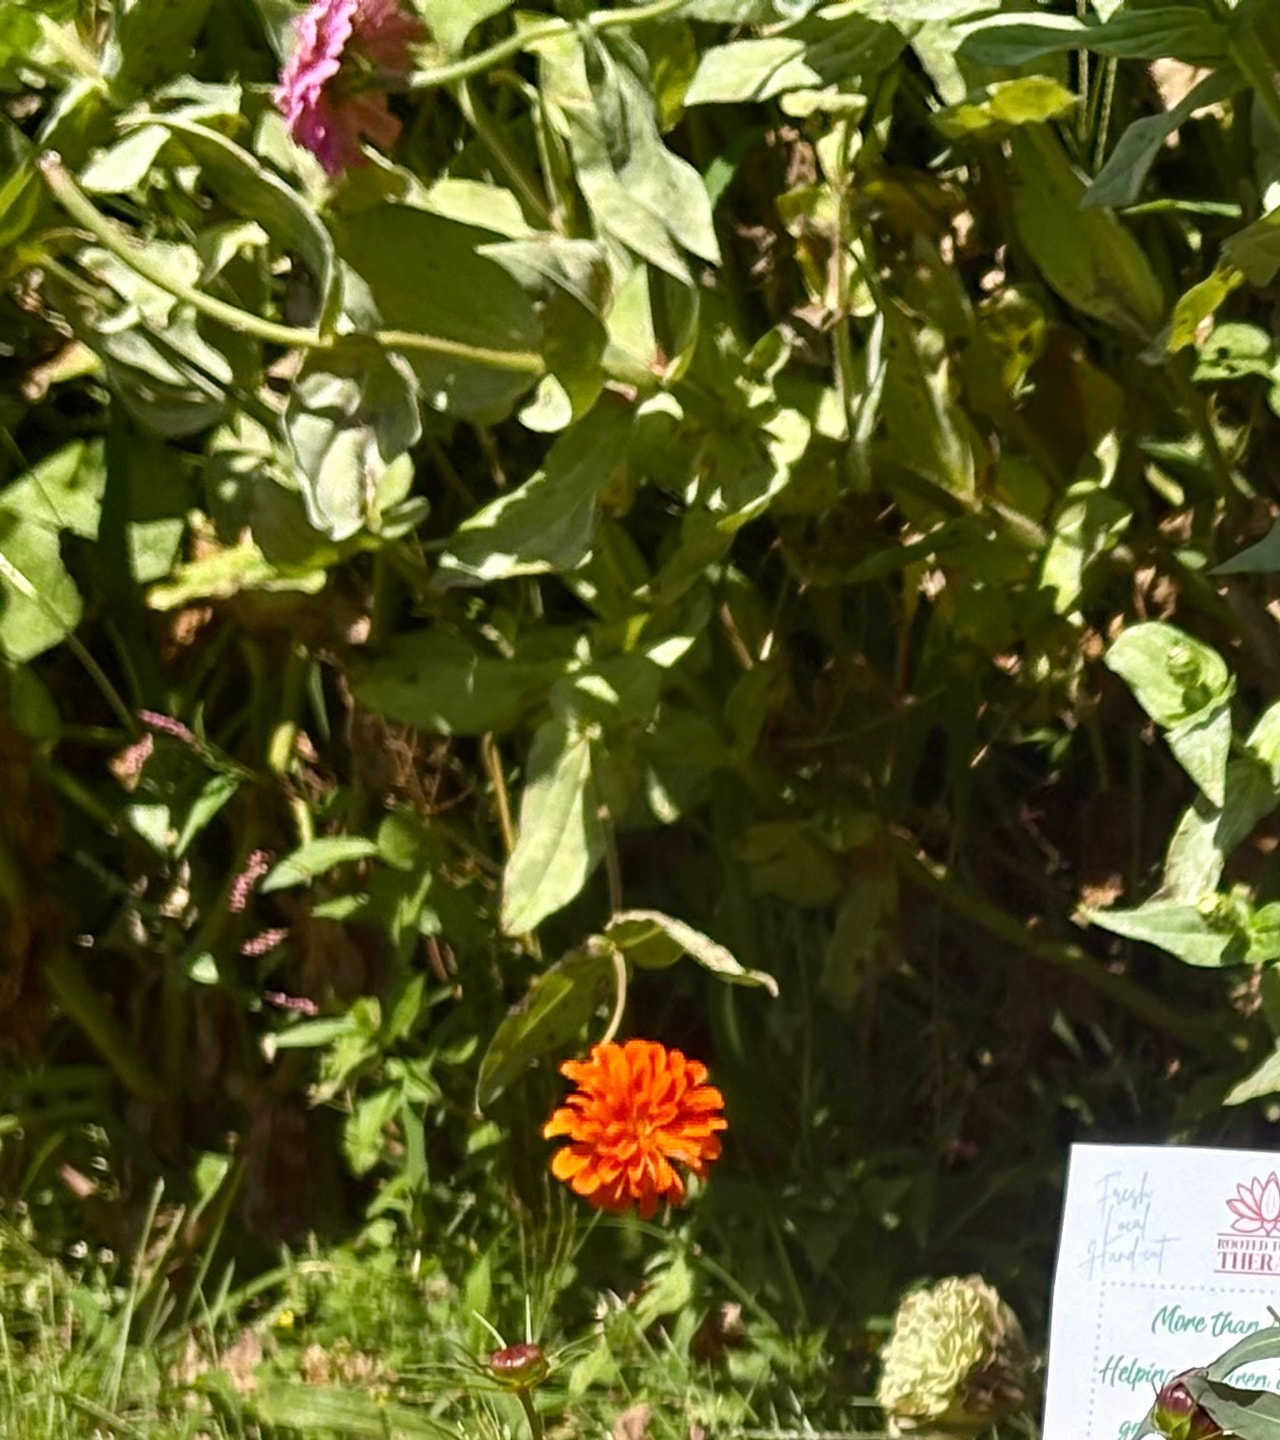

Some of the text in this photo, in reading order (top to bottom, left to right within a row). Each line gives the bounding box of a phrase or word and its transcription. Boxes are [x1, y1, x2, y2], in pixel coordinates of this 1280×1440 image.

[1217, 1238, 1269, 1252] ROOTED
[1151, 1304, 1207, 1335] More
[1210, 1311, 1260, 1338] than
